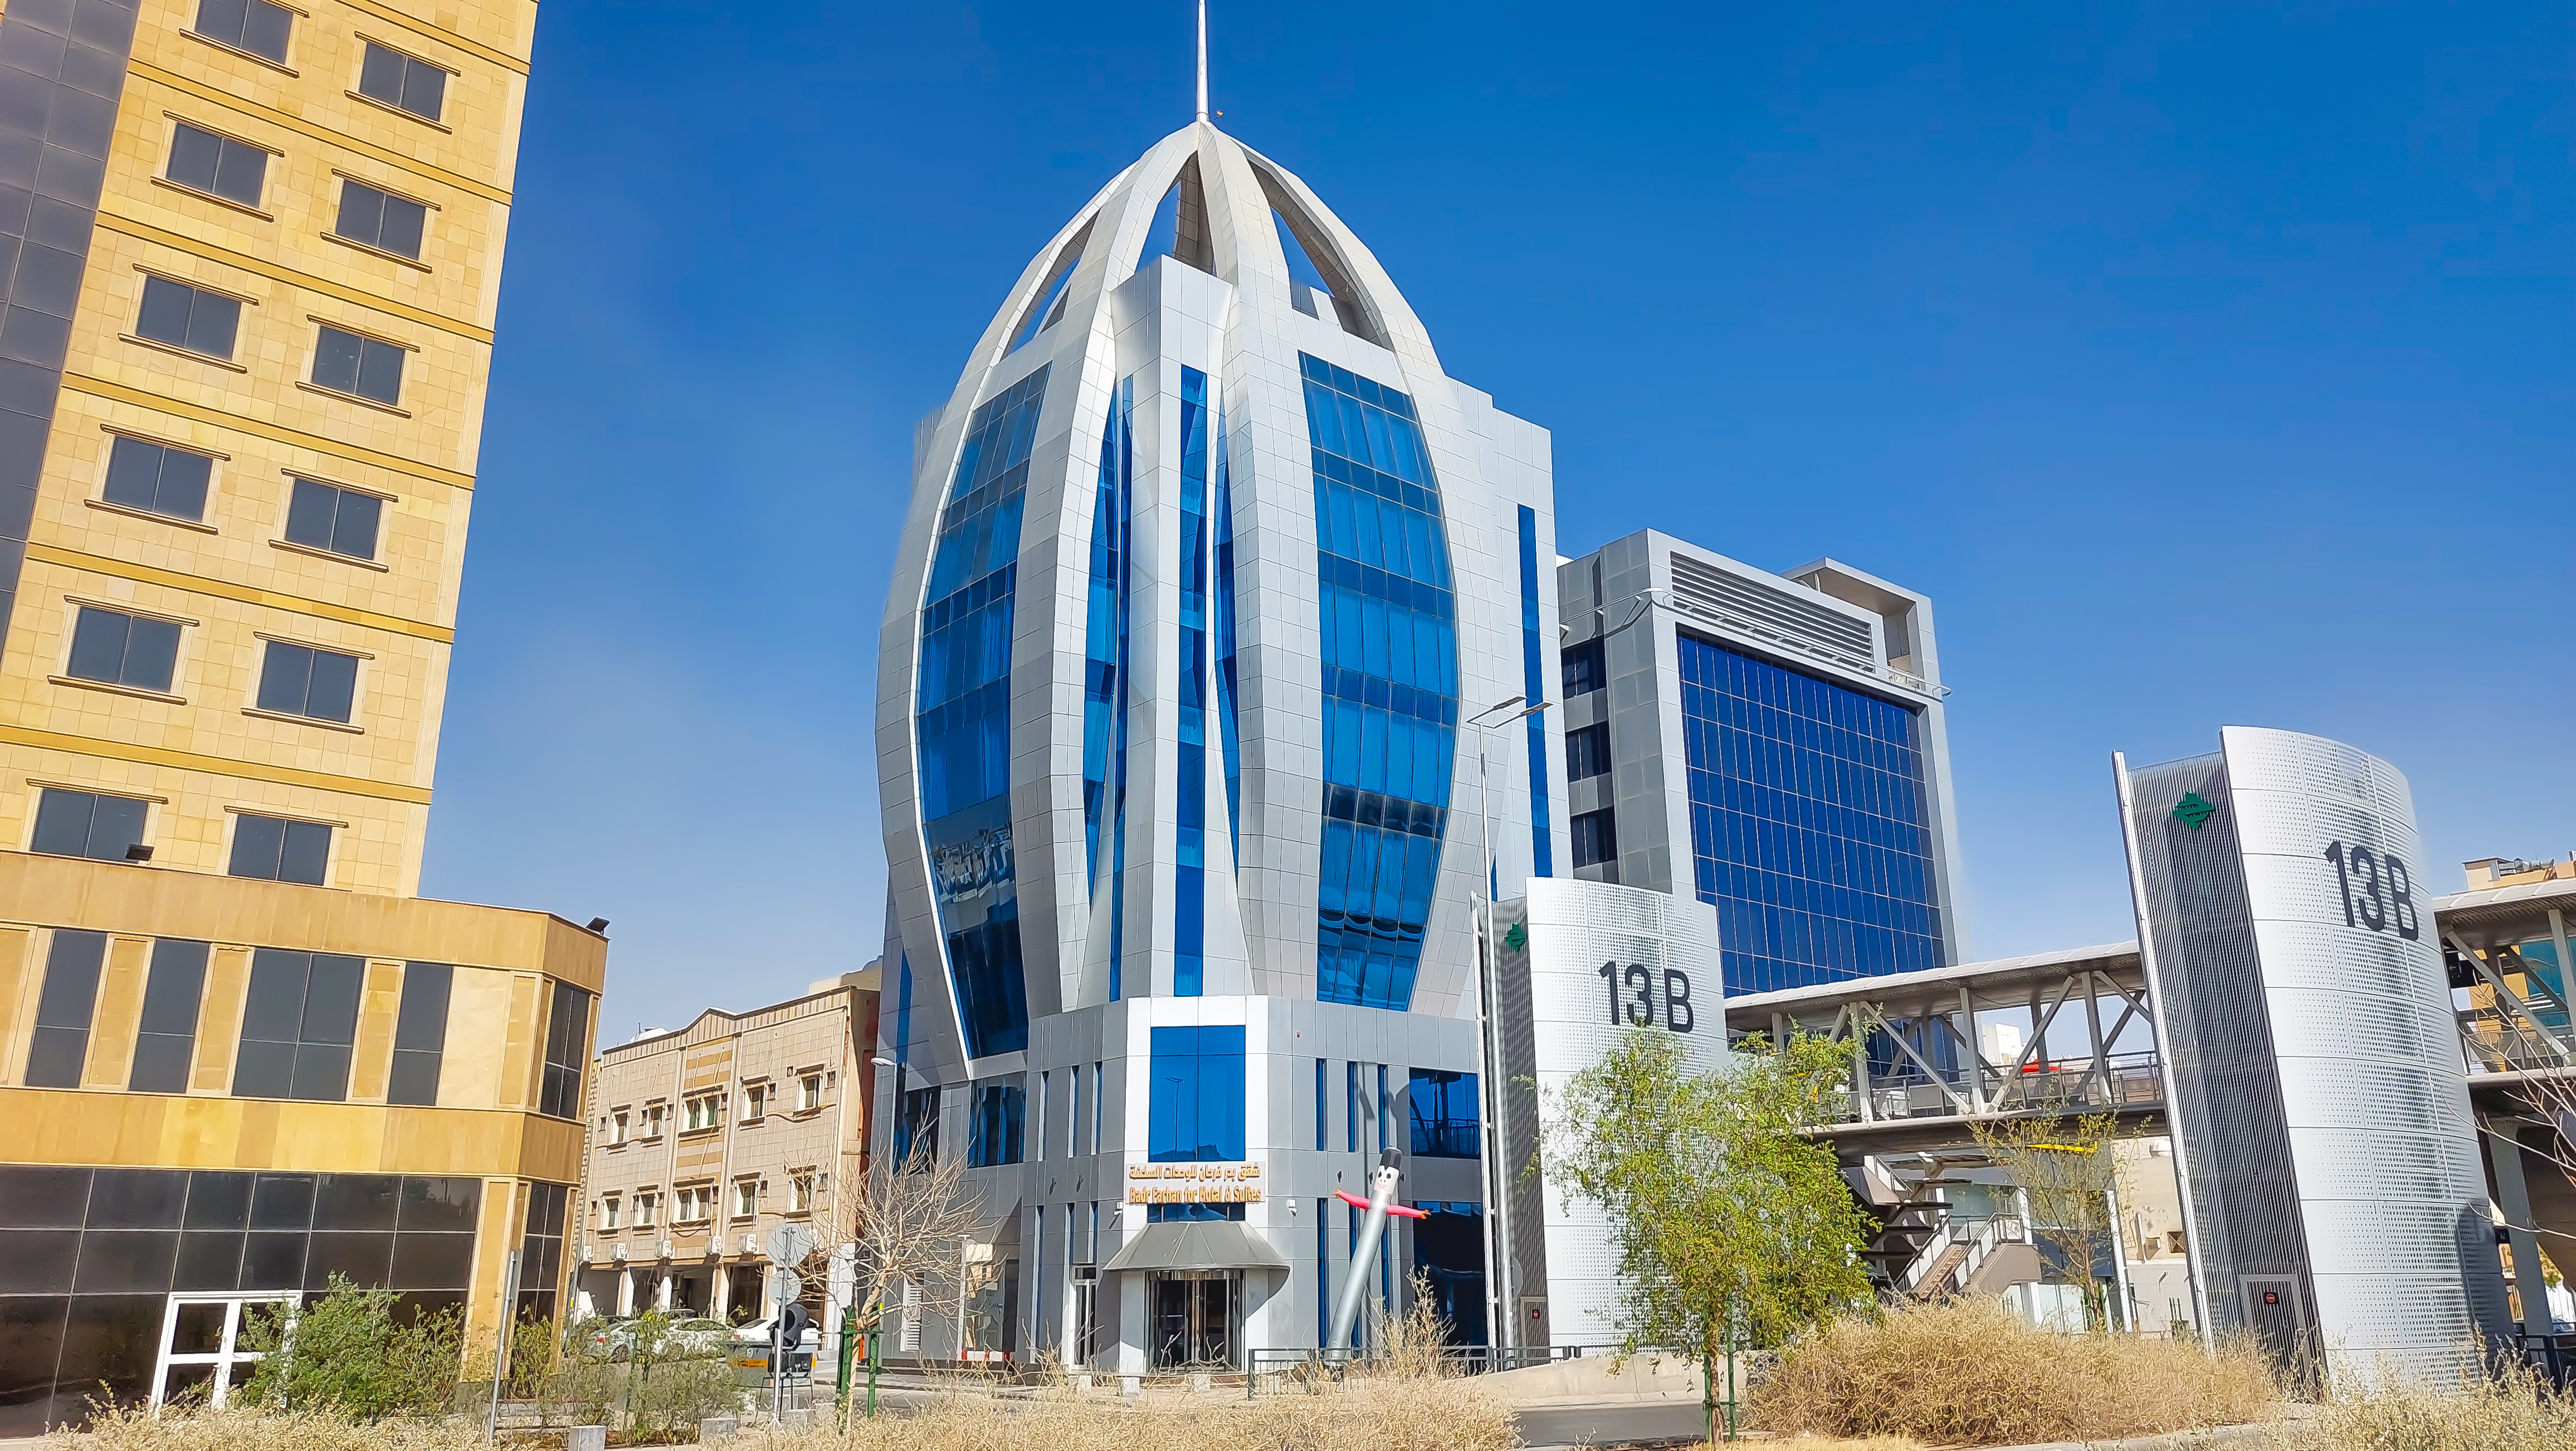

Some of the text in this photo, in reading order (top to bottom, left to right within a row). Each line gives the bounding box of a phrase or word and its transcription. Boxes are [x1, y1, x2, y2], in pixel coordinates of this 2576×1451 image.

[2323, 840, 2419, 942] 13B
[1598, 960, 1694, 1033] 13B
[1129, 1162, 1260, 1182] شقق بدر فرحان للوحدات السكنية
[1129, 1186, 1150, 1204] Badr
[1152, 1186, 1182, 1204] Farhan
[1184, 1185, 1197, 1203] for
[1224, 1185, 1232, 1202] &
[1233, 1185, 1261, 1202] Suites
